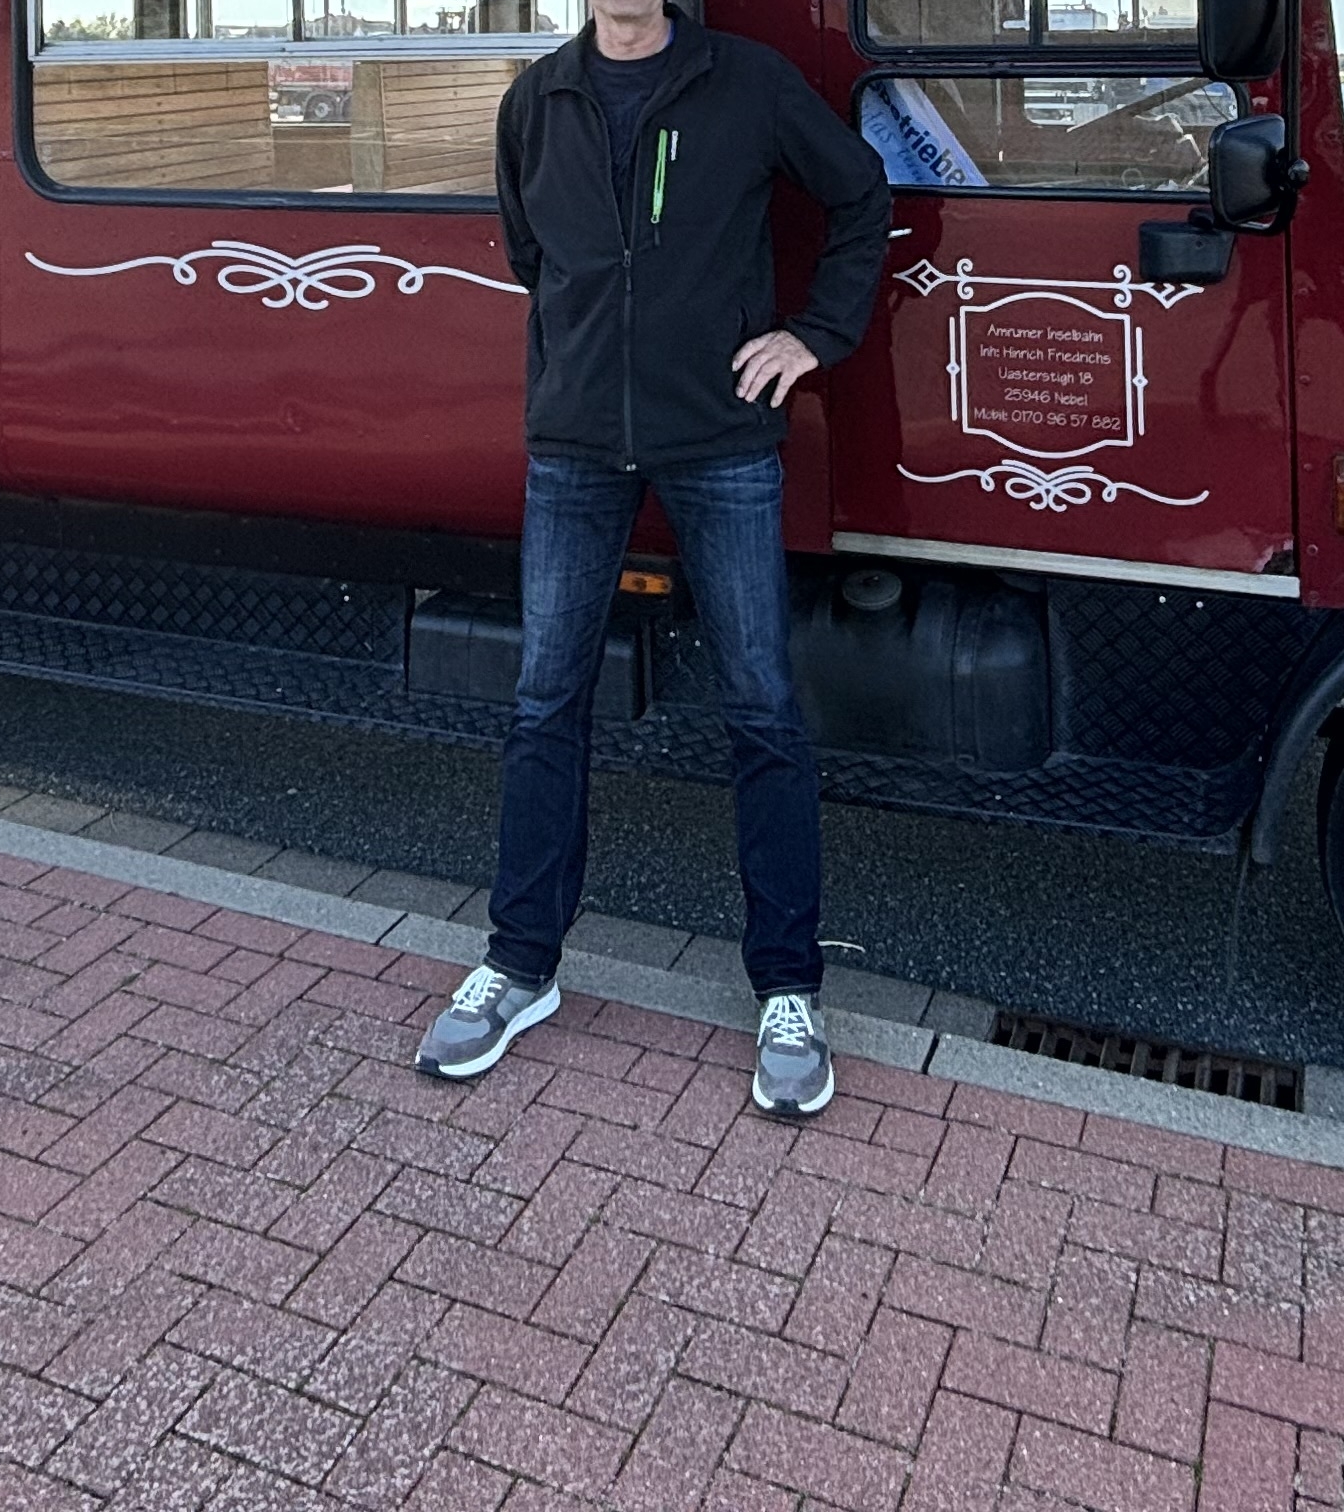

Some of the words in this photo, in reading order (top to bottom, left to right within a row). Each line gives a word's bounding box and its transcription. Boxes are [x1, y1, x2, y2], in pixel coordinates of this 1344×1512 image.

[986, 323, 1043, 340] Amrumer
[1047, 327, 1104, 343] Inselbahn
[1003, 346, 1044, 361] Hinrich
[1047, 348, 1112, 365] Friedrichs
[1078, 372, 1094, 385] 18
[1004, 388, 1051, 404] 25946
[1054, 391, 1089, 406] Nebel
[1011, 409, 1043, 424] 0170
[1046, 412, 1067, 426] 96
[1070, 414, 1088, 427] 57
[1091, 415, 1122, 431] 882
